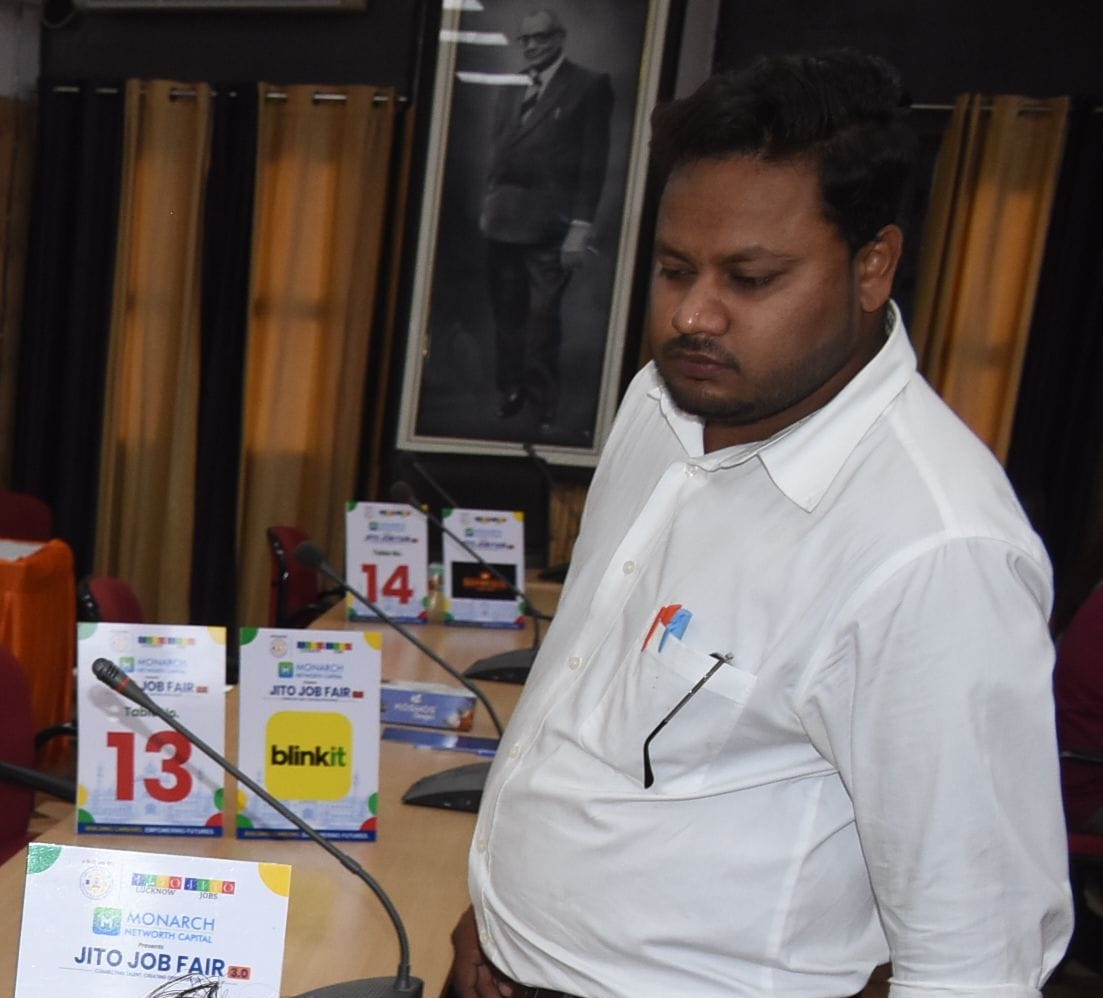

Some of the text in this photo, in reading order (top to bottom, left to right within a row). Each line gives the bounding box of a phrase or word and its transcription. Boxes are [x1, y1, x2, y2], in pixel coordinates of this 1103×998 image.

[361, 563, 414, 605] 14
[142, 681, 165, 692] JOB
[167, 682, 194, 692] FAIR
[270, 685, 296, 696] JITO
[298, 686, 322, 697] JOB
[324, 687, 351, 698] FAIR
[271, 744, 346, 767] blinkit
[107, 730, 192, 803] 13
[136, 886, 218, 900] LUCKNOW JOBS
[127, 912, 215, 931] MONARCH
[124, 928, 213, 944] NETWORTH CAPITAL
[74, 946, 249, 978] JITO JOB FAIR 3.0
